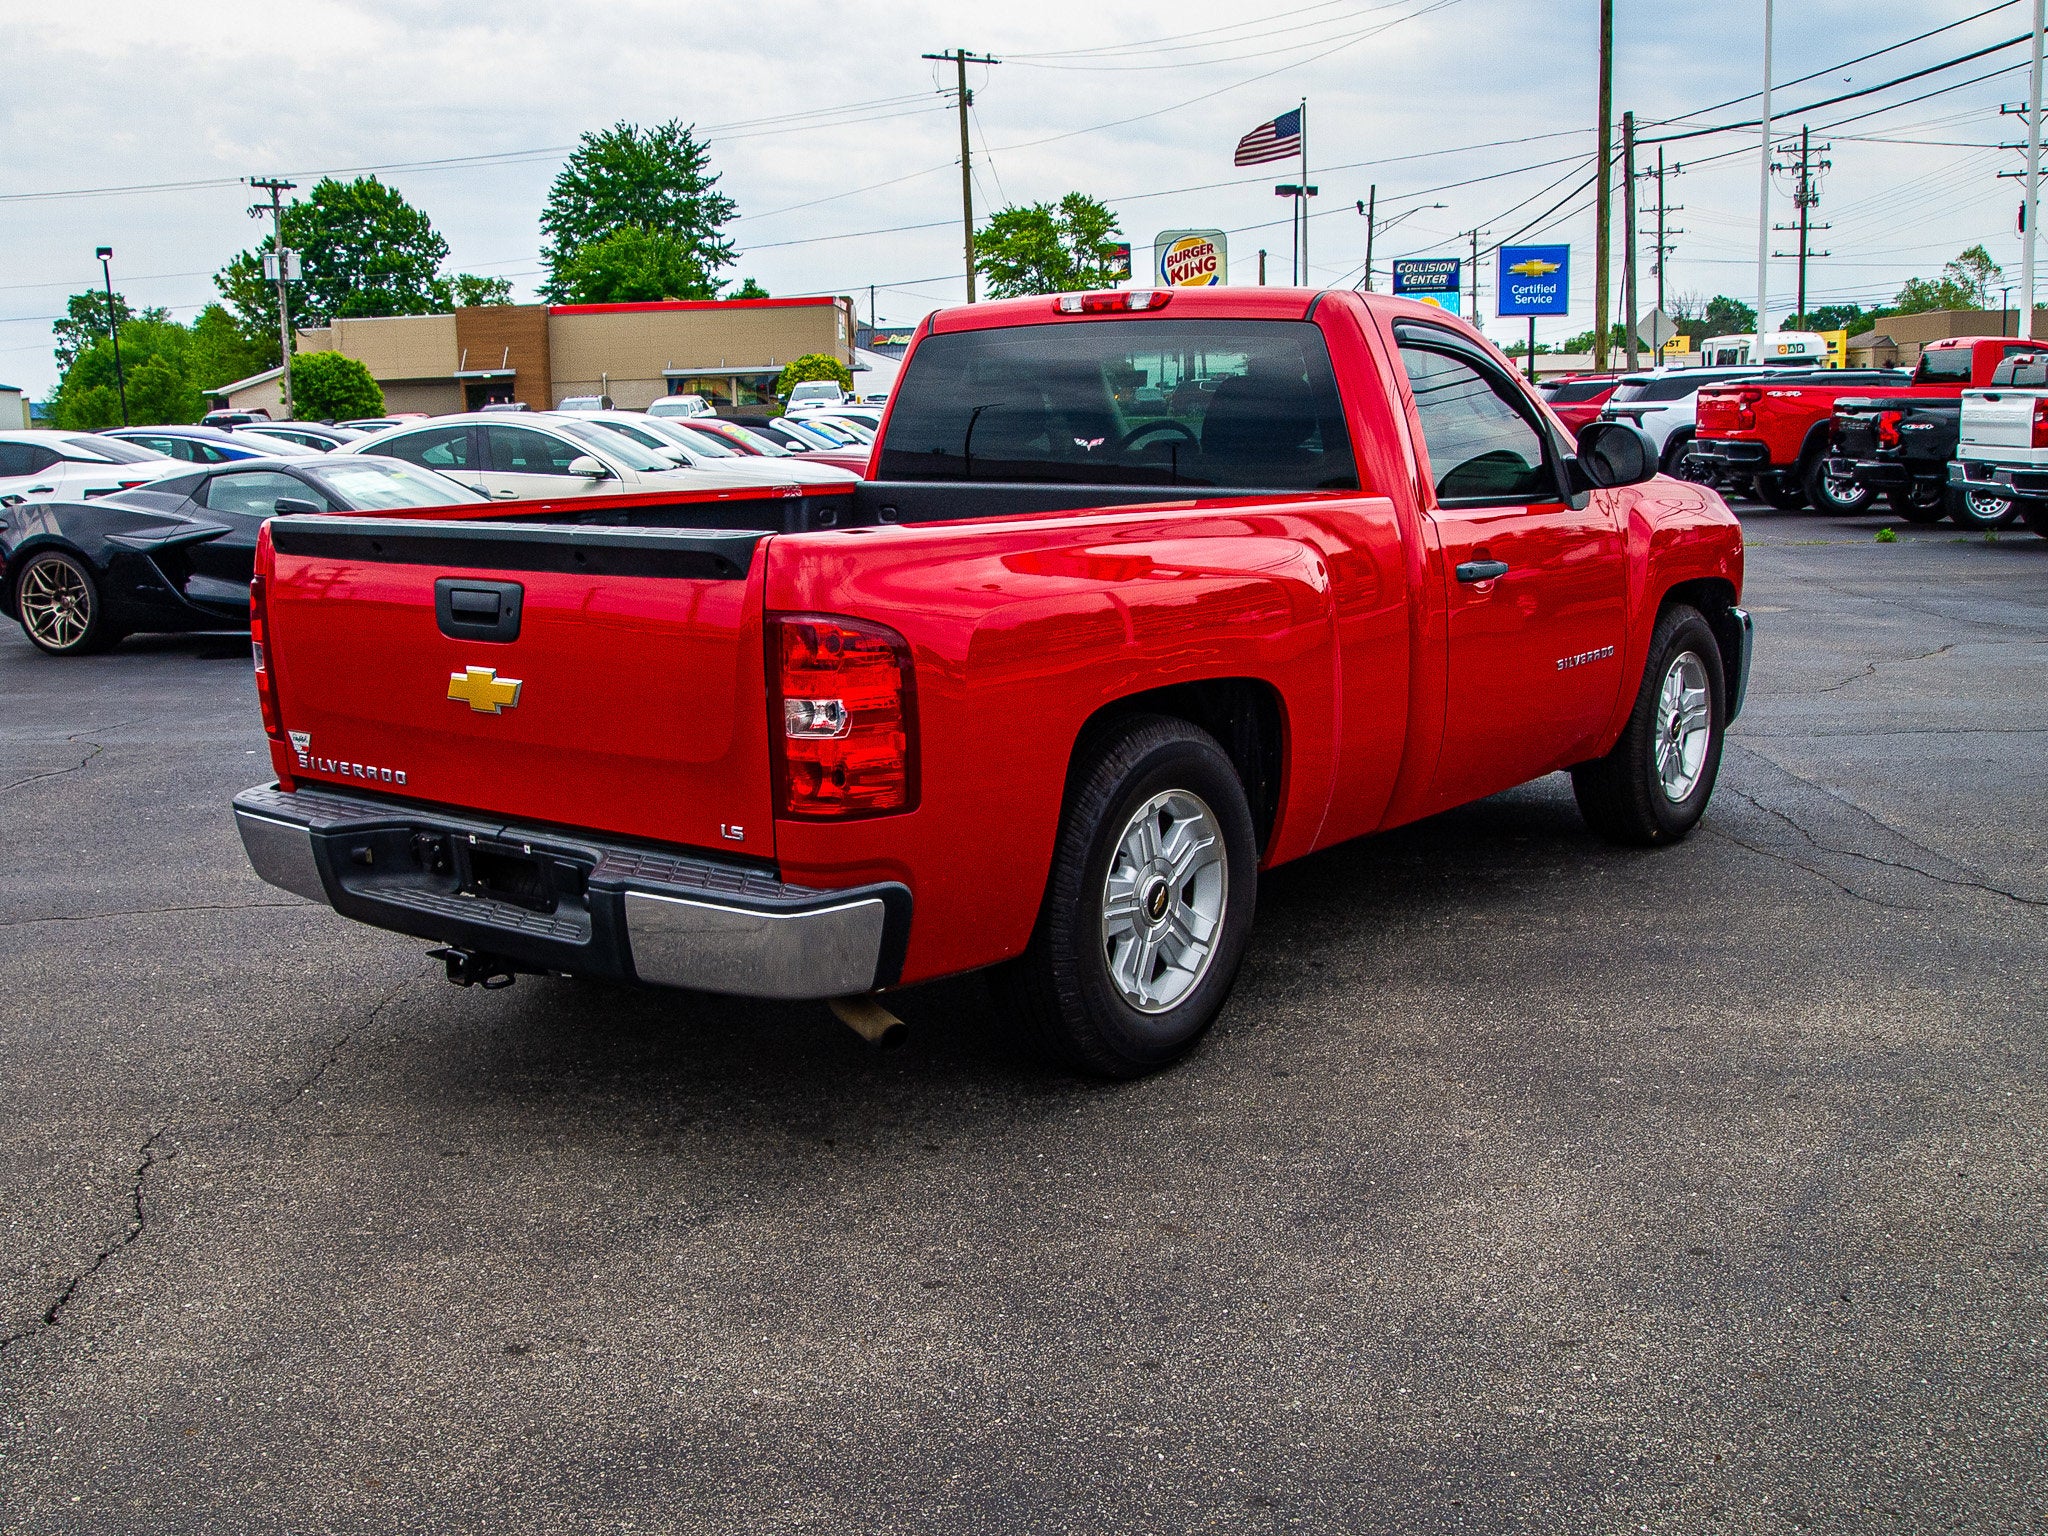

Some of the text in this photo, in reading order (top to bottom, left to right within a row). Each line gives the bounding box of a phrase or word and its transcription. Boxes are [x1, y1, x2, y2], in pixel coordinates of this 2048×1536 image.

[1167, 243, 1214, 268] BURGER
[1170, 256, 1217, 285] KING
[1397, 262, 1456, 273] COLLISION
[1403, 274, 1447, 284] CENTER
[1511, 284, 1557, 294] Certified
[1515, 294, 1553, 304] Service
[1557, 645, 1615, 671] SILVERADO
[299, 754, 406, 784] SILVERADO
[720, 823, 744, 841] LS
